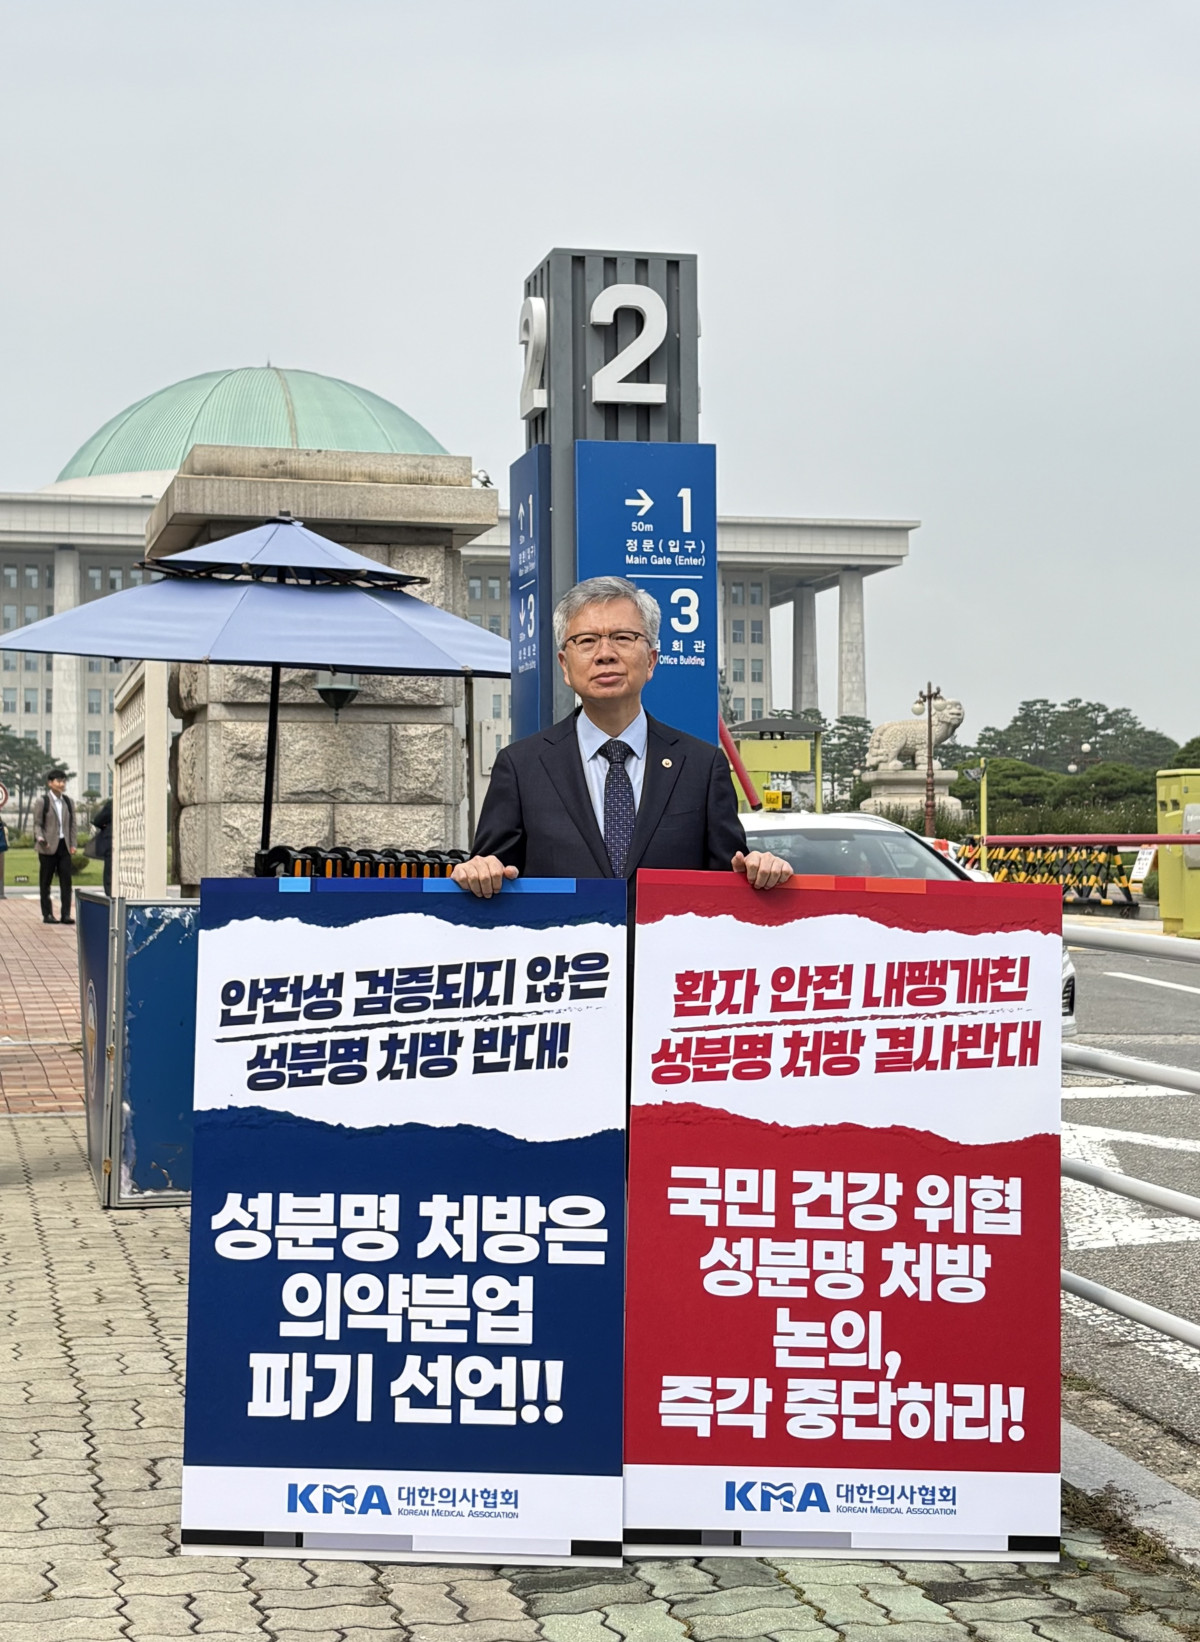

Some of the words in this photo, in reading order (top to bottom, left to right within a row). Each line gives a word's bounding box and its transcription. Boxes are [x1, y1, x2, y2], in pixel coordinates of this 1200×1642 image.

[590, 284, 667, 403] 2
[632, 522, 653, 531] 50m
[677, 488, 691, 532] 1
[626, 555, 647, 564] Main
[651, 555, 671, 564] Gate
[675, 555, 705, 566] (Enter)
[671, 588, 699, 633] 3
[659, 655, 677, 664] Office
[680, 656, 705, 666] Building
[218, 971, 345, 1028] 안전성
[352, 958, 517, 1019] 검증되지
[524, 952, 610, 1003] 않은
[672, 967, 761, 1018] 환자
[769, 963, 855, 1014] 안전
[862, 955, 1031, 1008] 내팽개친
[245, 1037, 370, 1092] 성분명
[376, 1029, 465, 1082] 처방
[471, 1021, 572, 1075] 반대!
[650, 1032, 774, 1086] 성분명
[780, 1029, 866, 1079] 처방
[873, 1020, 1043, 1075] 결사반대
[211, 1192, 400, 1262] 성분명
[416, 1194, 608, 1266] 처방은
[667, 1165, 777, 1228] 국민
[791, 1170, 903, 1232] 건강
[913, 1174, 1023, 1236] 위협
[700, 1237, 865, 1300] 성분명
[879, 1241, 992, 1304] 처방
[279, 1272, 534, 1345] 의약분업
[773, 1307, 902, 1380] 논의,
[247, 1352, 374, 1422] 파기
[389, 1354, 564, 1426] 선언!!
[658, 1375, 773, 1438] 즉각
[783, 1378, 1026, 1443] 중단하라!
[287, 1483, 392, 1515] KMA
[398, 1486, 519, 1509] 대한의사협회
[725, 1481, 830, 1513] KMA
[836, 1483, 956, 1506] 대한의사협회
